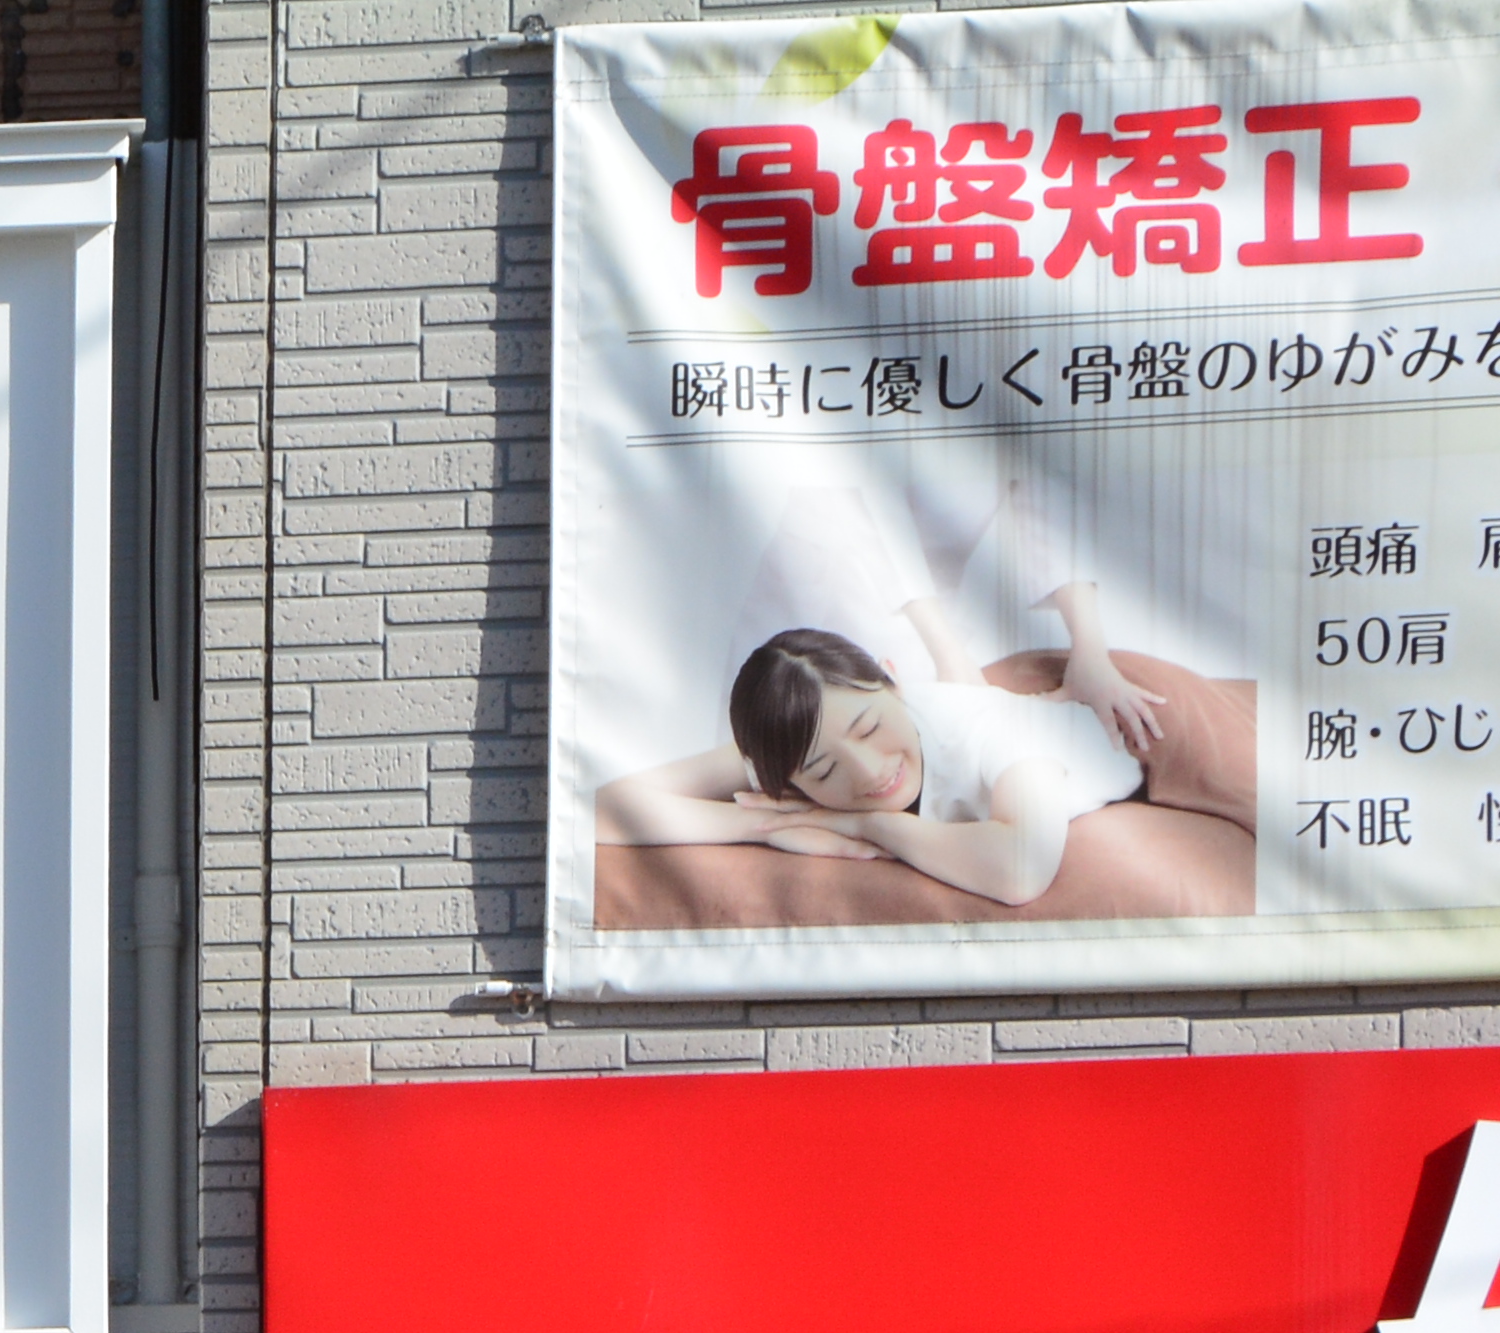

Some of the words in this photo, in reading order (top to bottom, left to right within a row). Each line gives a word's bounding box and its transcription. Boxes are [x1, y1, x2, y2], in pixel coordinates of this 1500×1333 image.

[671, 96, 1424, 298] 骨盤矯正
[1309, 522, 1420, 578] 頭痛
[1316, 612, 1450, 667] 50肩
[1304, 703, 1494, 761] 腕・ひじ
[1295, 796, 1412, 849] 不眠
